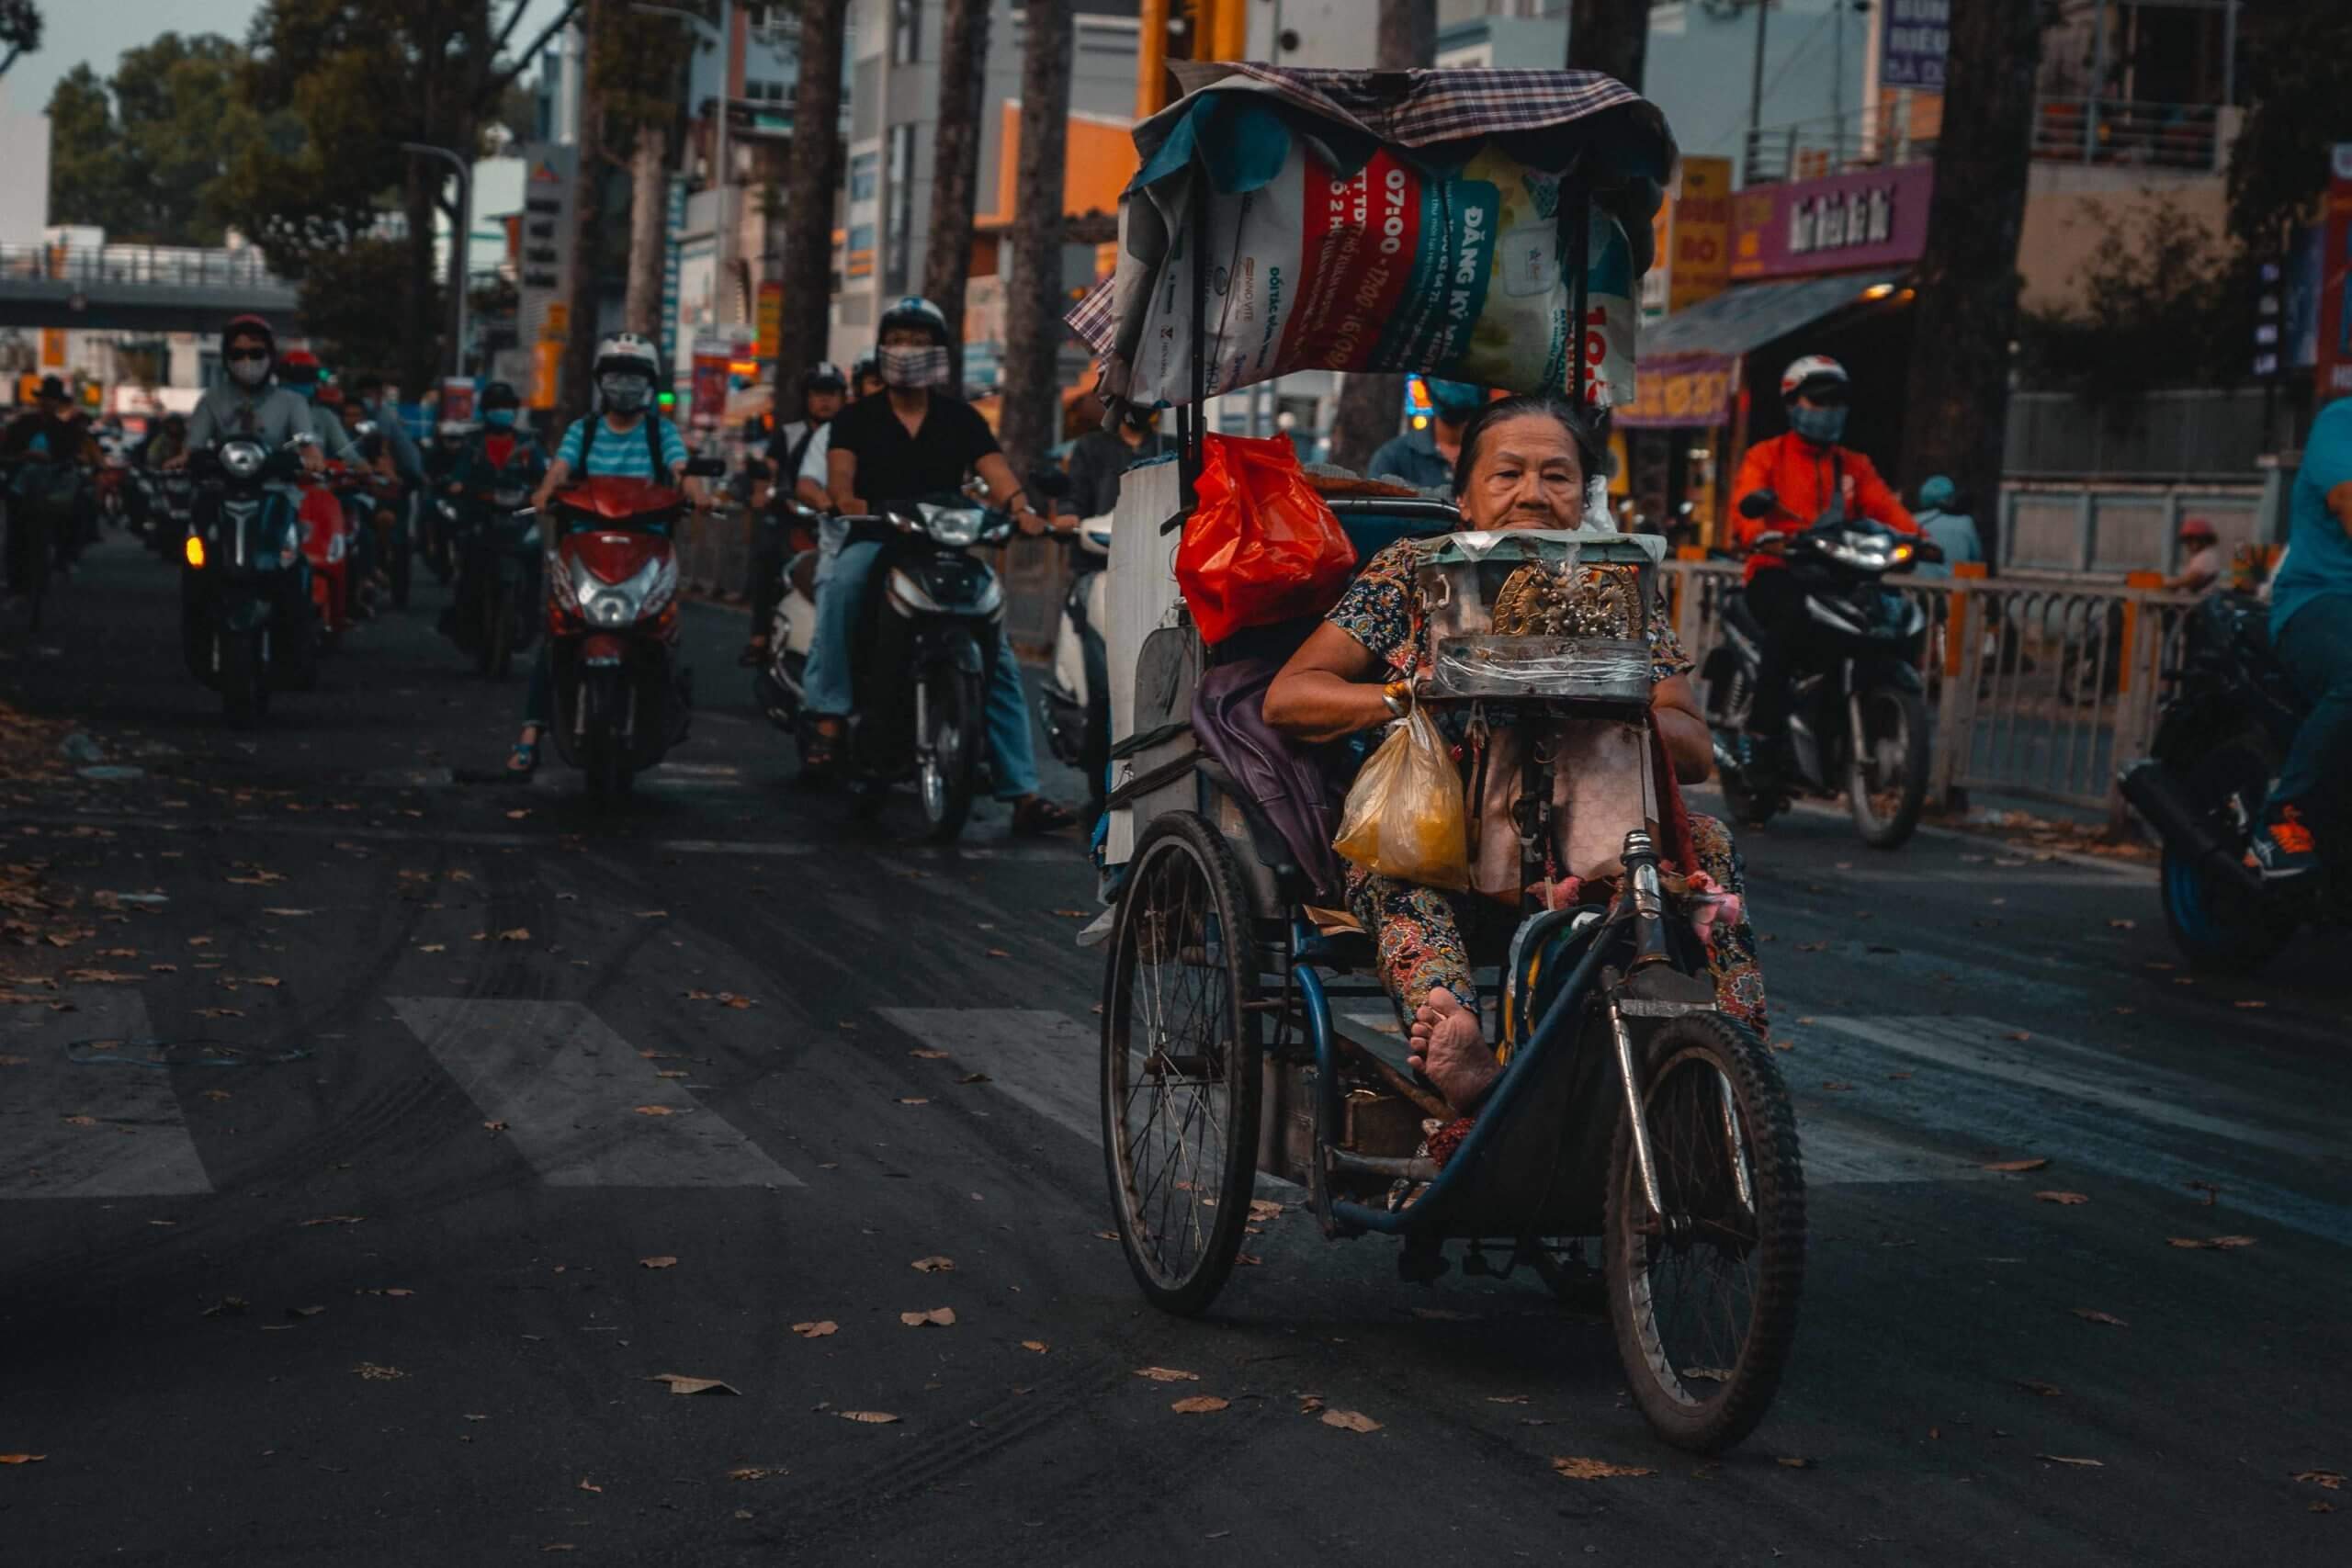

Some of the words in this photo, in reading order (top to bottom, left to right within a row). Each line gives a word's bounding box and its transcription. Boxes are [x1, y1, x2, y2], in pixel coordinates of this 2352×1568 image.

[1329, 199, 1344, 211] 2
[1379, 169, 1406, 254] 07:00
[1455, 206, 1486, 285] ĐĂNG
[1269, 266, 1284, 290] ĐỐI
[1354, 266, 1390, 309] 17:00
[1447, 289, 1471, 320] KÝ
